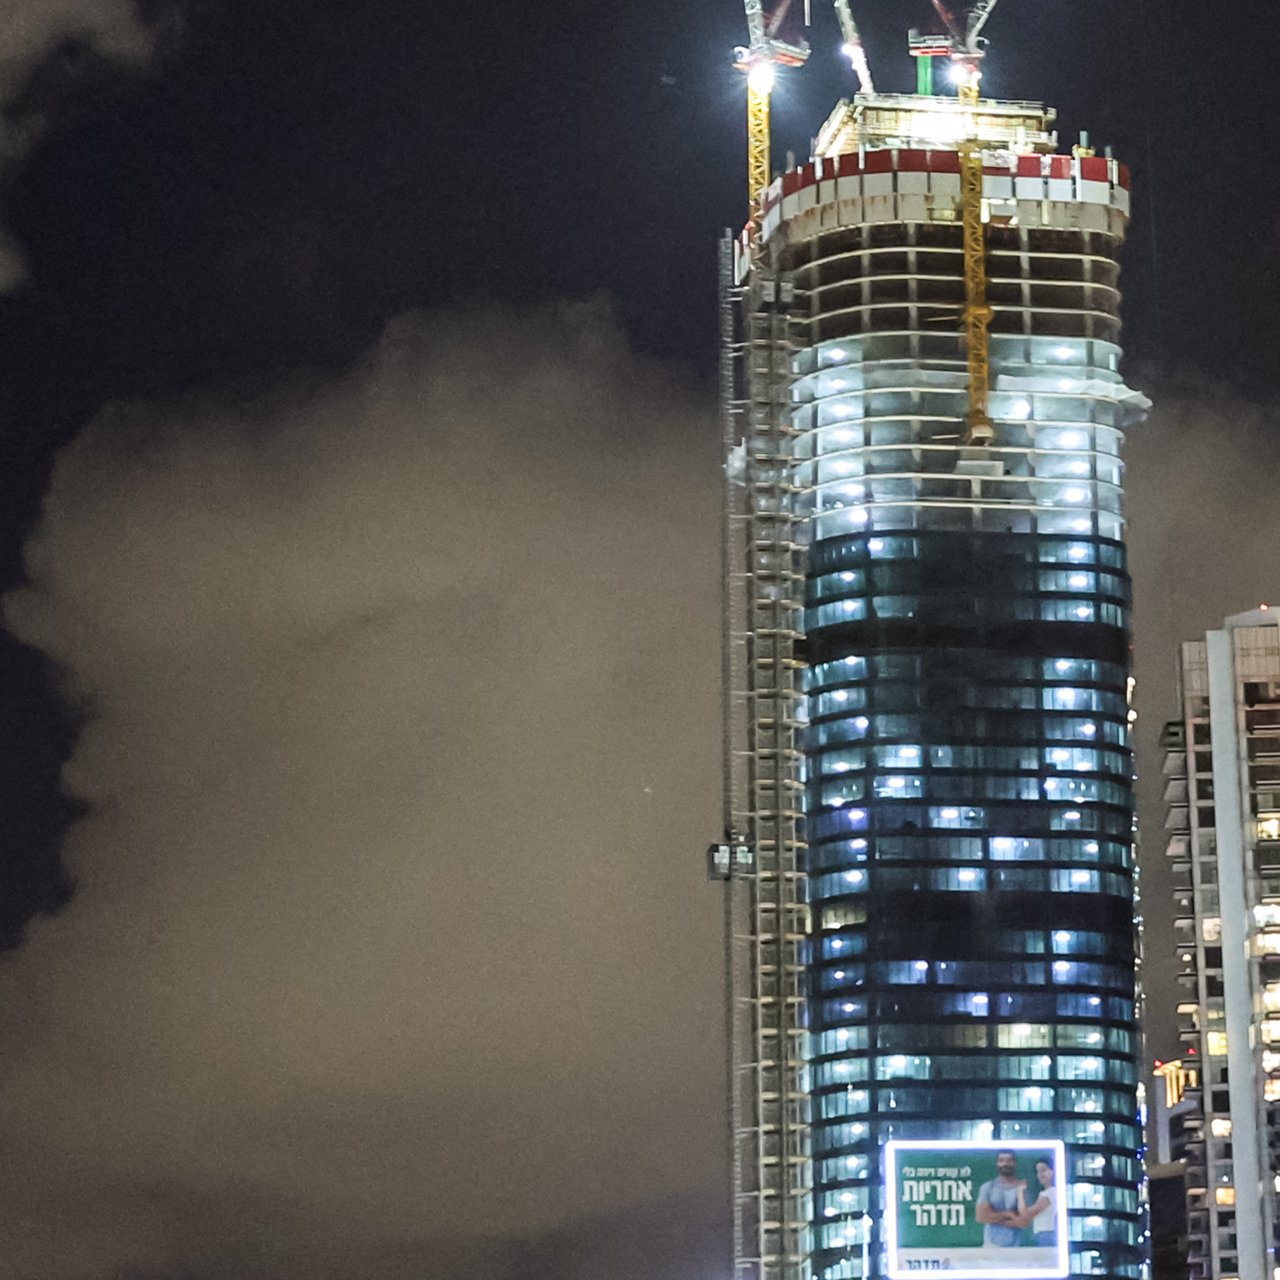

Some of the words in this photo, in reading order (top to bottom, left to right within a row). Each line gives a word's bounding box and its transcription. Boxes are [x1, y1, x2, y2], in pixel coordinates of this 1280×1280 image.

[902, 1180, 973, 1201] אחריות
[910, 1204, 965, 1226] תדהר
[906, 1259, 940, 1270] תדהר
